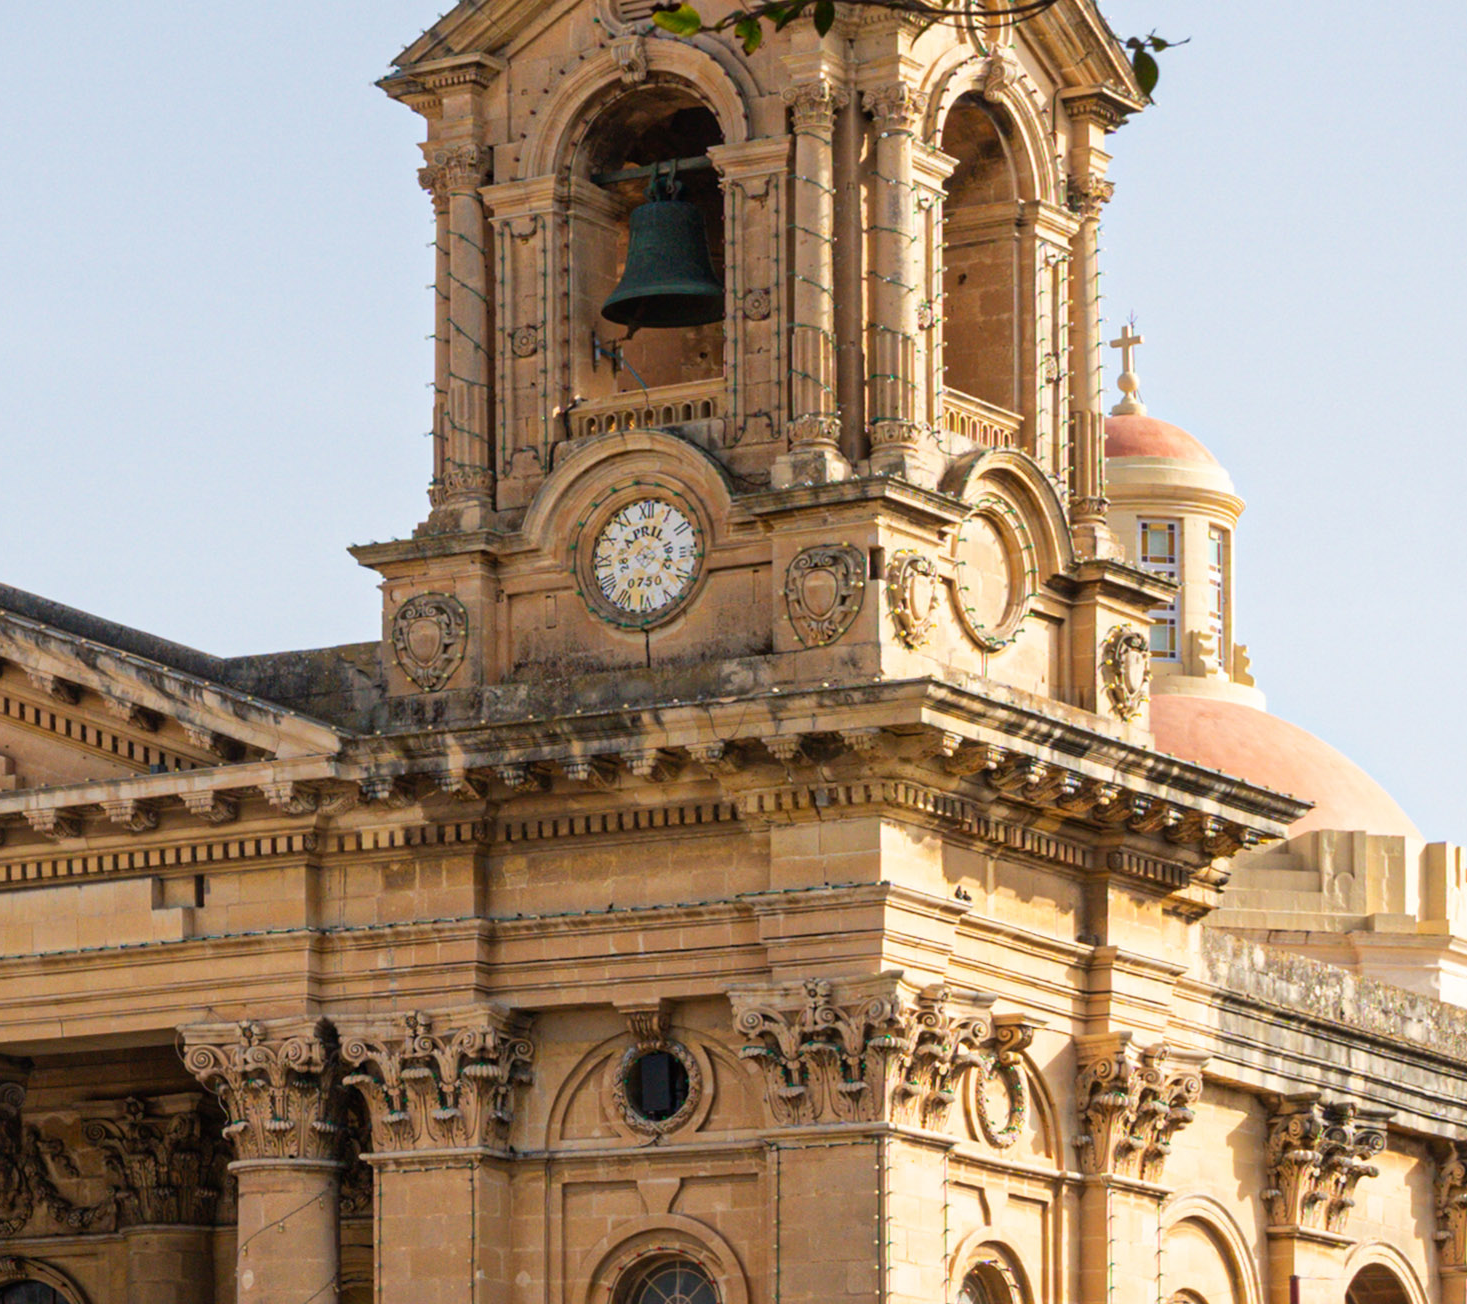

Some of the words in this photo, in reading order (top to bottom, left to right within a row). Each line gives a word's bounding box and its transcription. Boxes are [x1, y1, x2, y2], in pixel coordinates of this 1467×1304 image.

[639, 503, 654, 519] XII
[614, 511, 631, 532] XI
[674, 521, 690, 536] II
[601, 533, 617, 546] X
[624, 525, 663, 549] APRIL
[662, 541, 674, 570] 1942
[596, 554, 612, 569] IX
[627, 575, 662, 589] 0750
[675, 567, 690, 584] IV
[601, 573, 617, 596] VIII
[616, 588, 632, 608] VII
[640, 594, 652, 609] VI
[663, 589, 674, 601] V
